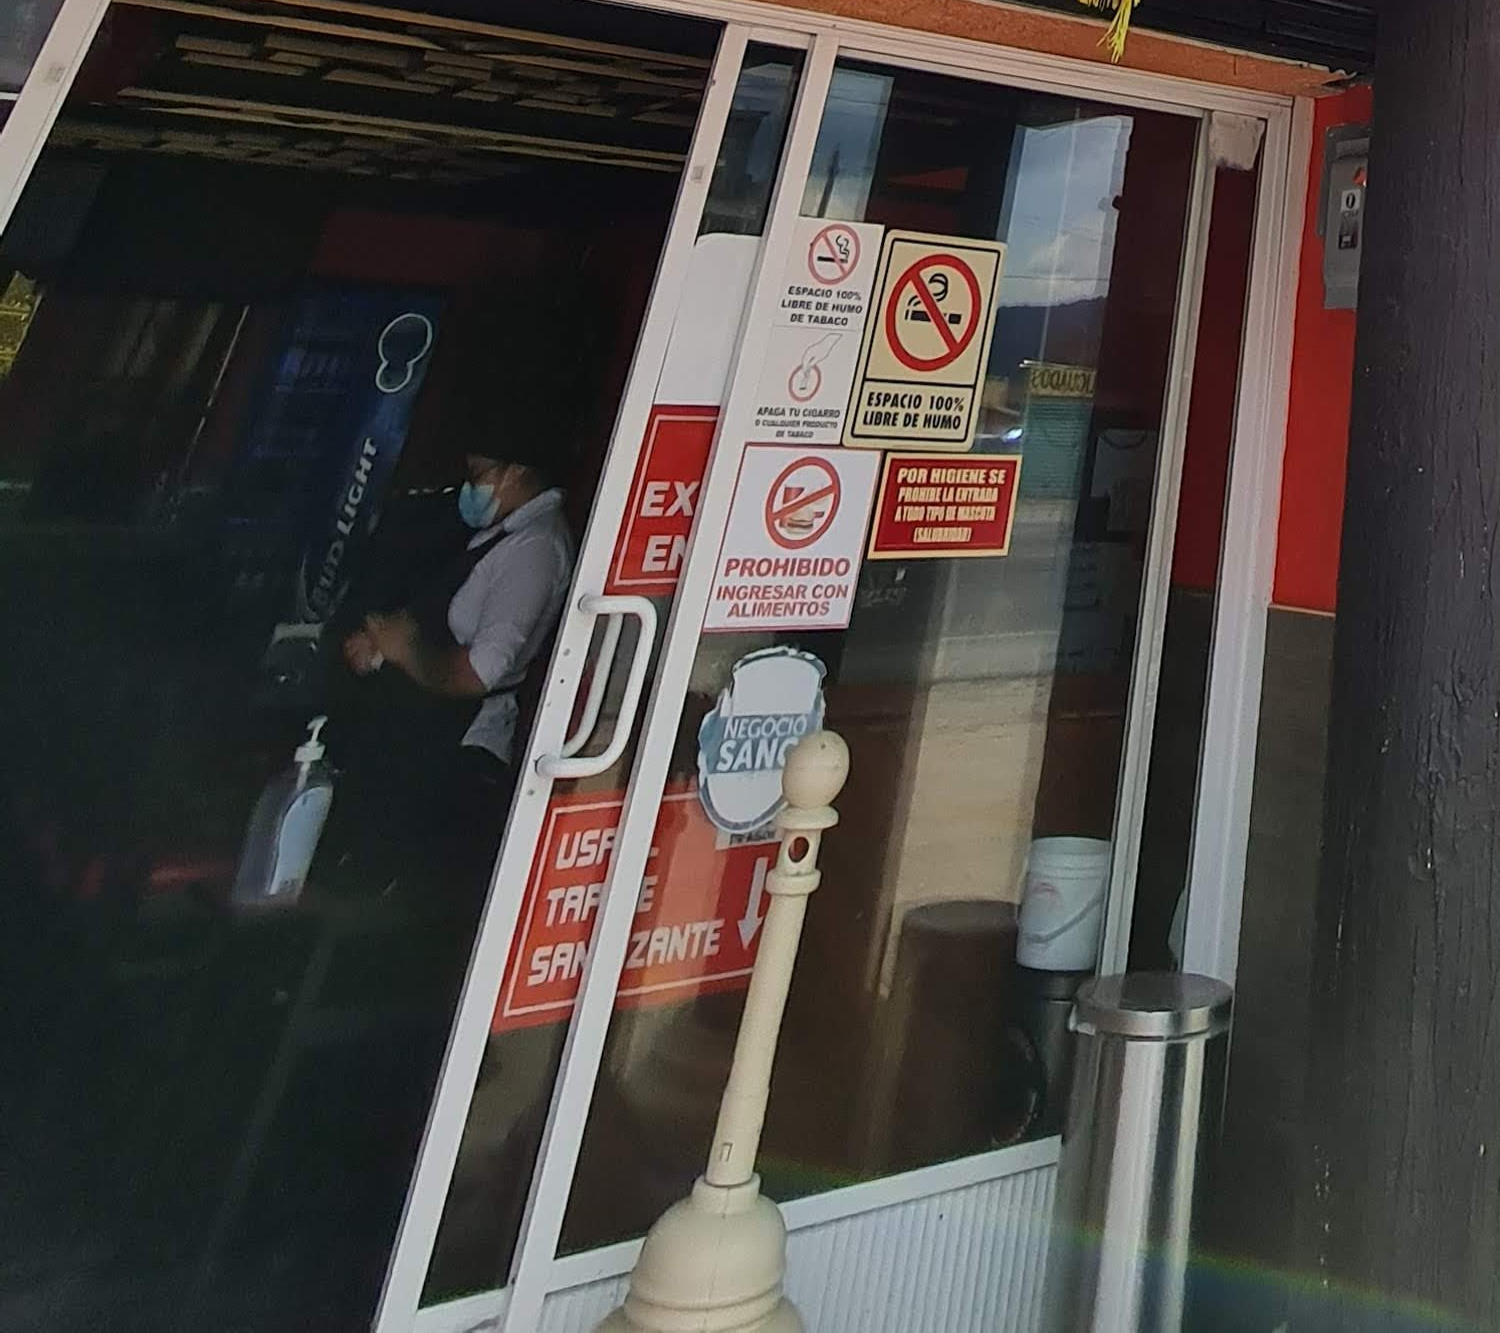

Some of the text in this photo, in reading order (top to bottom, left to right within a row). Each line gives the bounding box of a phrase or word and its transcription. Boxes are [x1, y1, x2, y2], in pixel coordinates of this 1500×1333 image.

[788, 285, 863, 301] ESPACIO 100%
[781, 299, 863, 314] LIBRE DE HUMO
[790, 313, 849, 326] DE TABACO
[866, 392, 965, 412] ESPACIO 100%
[757, 406, 841, 418] APAGA TU CIGARRO
[863, 411, 961, 430] LIBRE DE HUMO
[897, 467, 1007, 485] POR HIGIENE SE
[337, 437, 378, 535] LIGHT
[897, 487, 999, 502] PROHIBE LA ENTRADA
[894, 505, 902, 522] A
[926, 505, 946, 521] TIPO
[723, 557, 852, 578] PROHIBIDO
[716, 584, 848, 601] INGRESAR CON
[727, 601, 830, 618] ALIMENTOS
[723, 716, 808, 740] NEGOCIO
